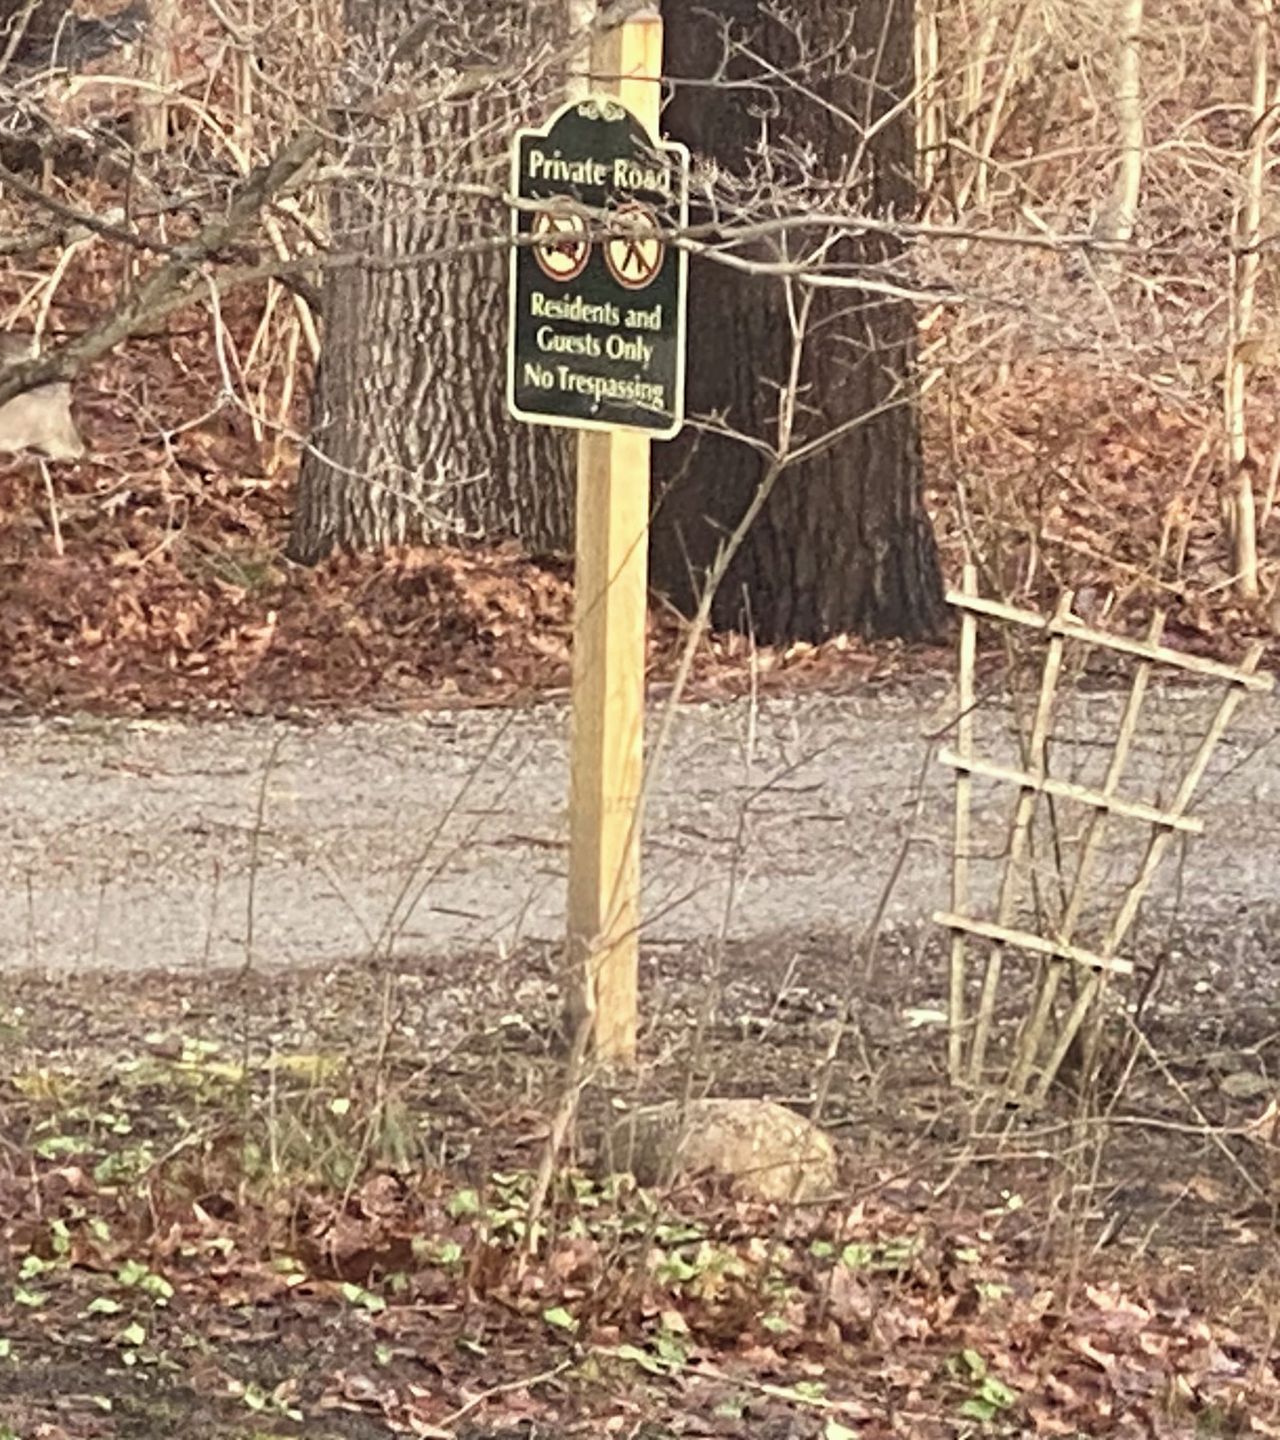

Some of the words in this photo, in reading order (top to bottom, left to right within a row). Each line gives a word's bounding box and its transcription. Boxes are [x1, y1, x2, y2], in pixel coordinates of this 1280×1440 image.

[528, 149, 605, 187] Private
[613, 157, 671, 192] Road
[531, 291, 620, 329] Residents
[624, 305, 662, 330] and
[536, 327, 601, 358] Guests
[606, 334, 654, 370] Only
[523, 363, 553, 389] No
[557, 366, 665, 410] Trespassing
